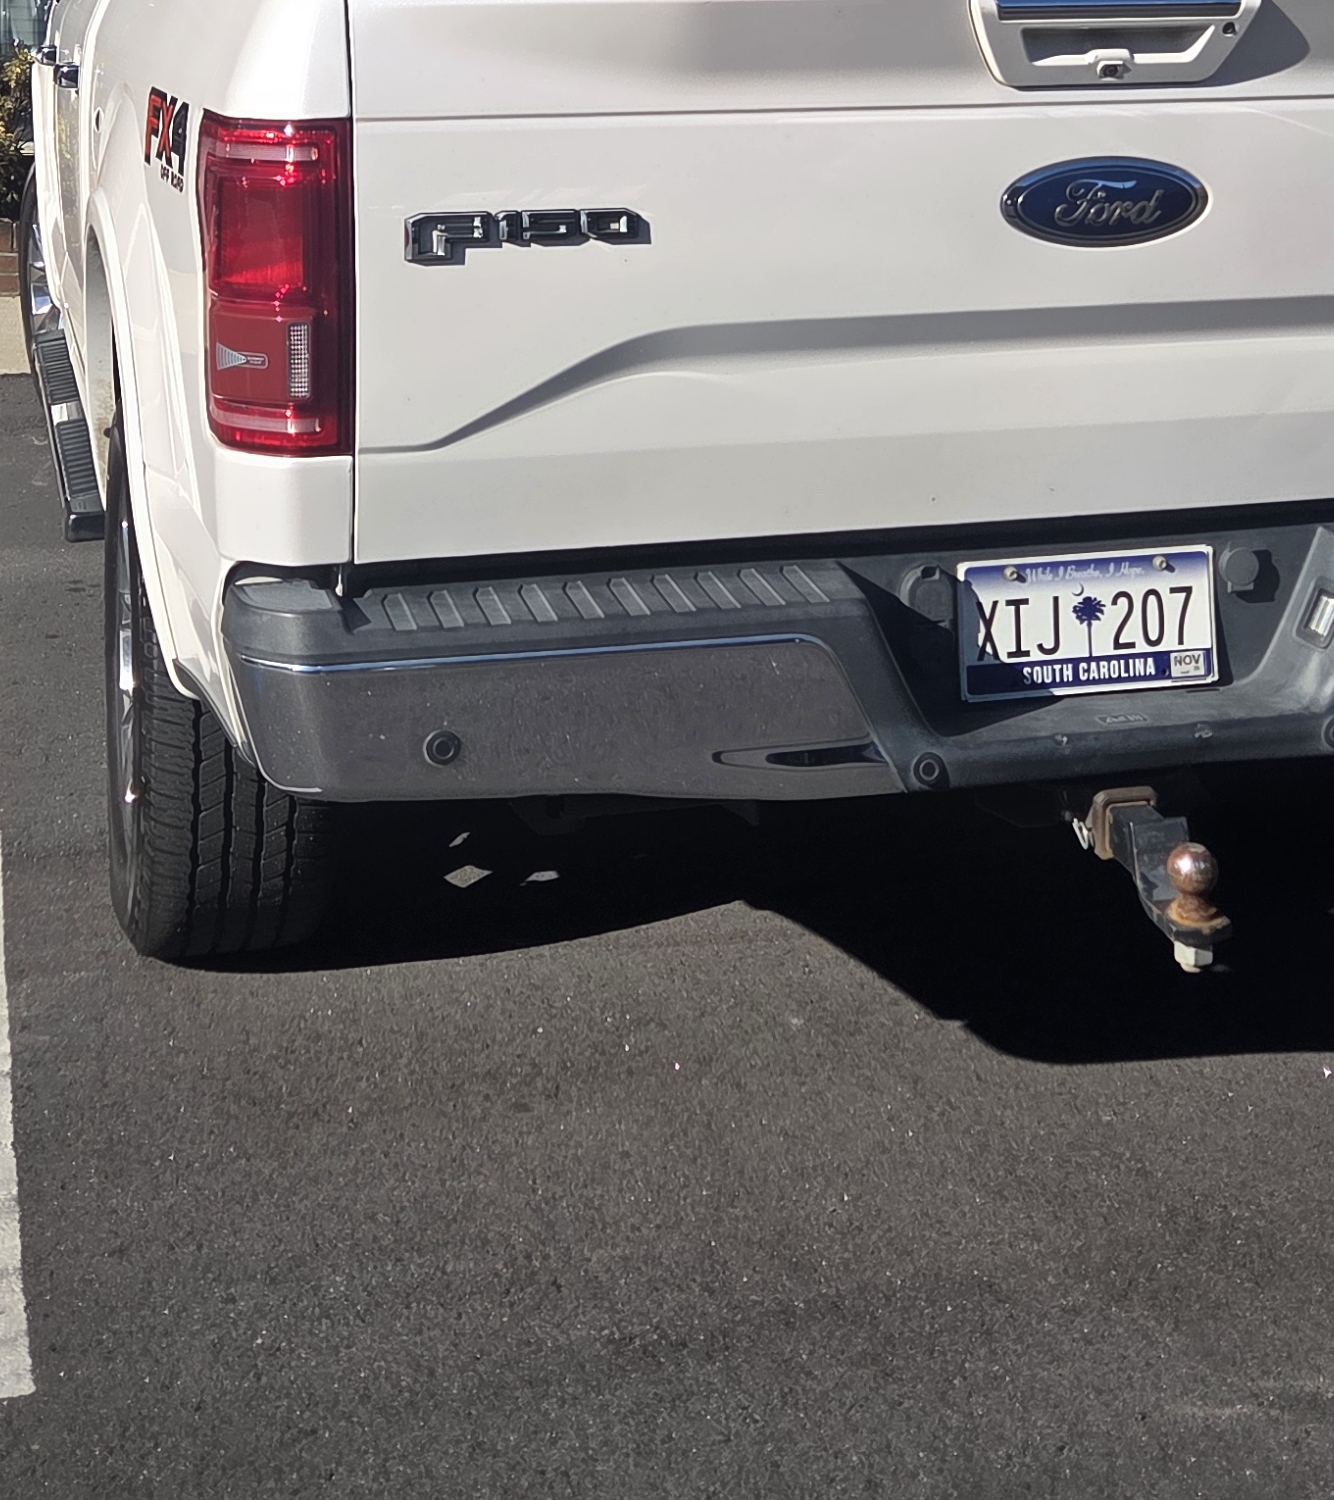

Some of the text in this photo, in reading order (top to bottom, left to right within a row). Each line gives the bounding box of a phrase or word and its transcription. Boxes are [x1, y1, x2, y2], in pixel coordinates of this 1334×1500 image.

[144, 86, 189, 176] FX4
[1054, 179, 1165, 227] Ford
[976, 586, 1193, 661] XIJ 207
[1023, 658, 1156, 685] SOUTH CAROLINA
[1174, 654, 1201, 667] NOV
